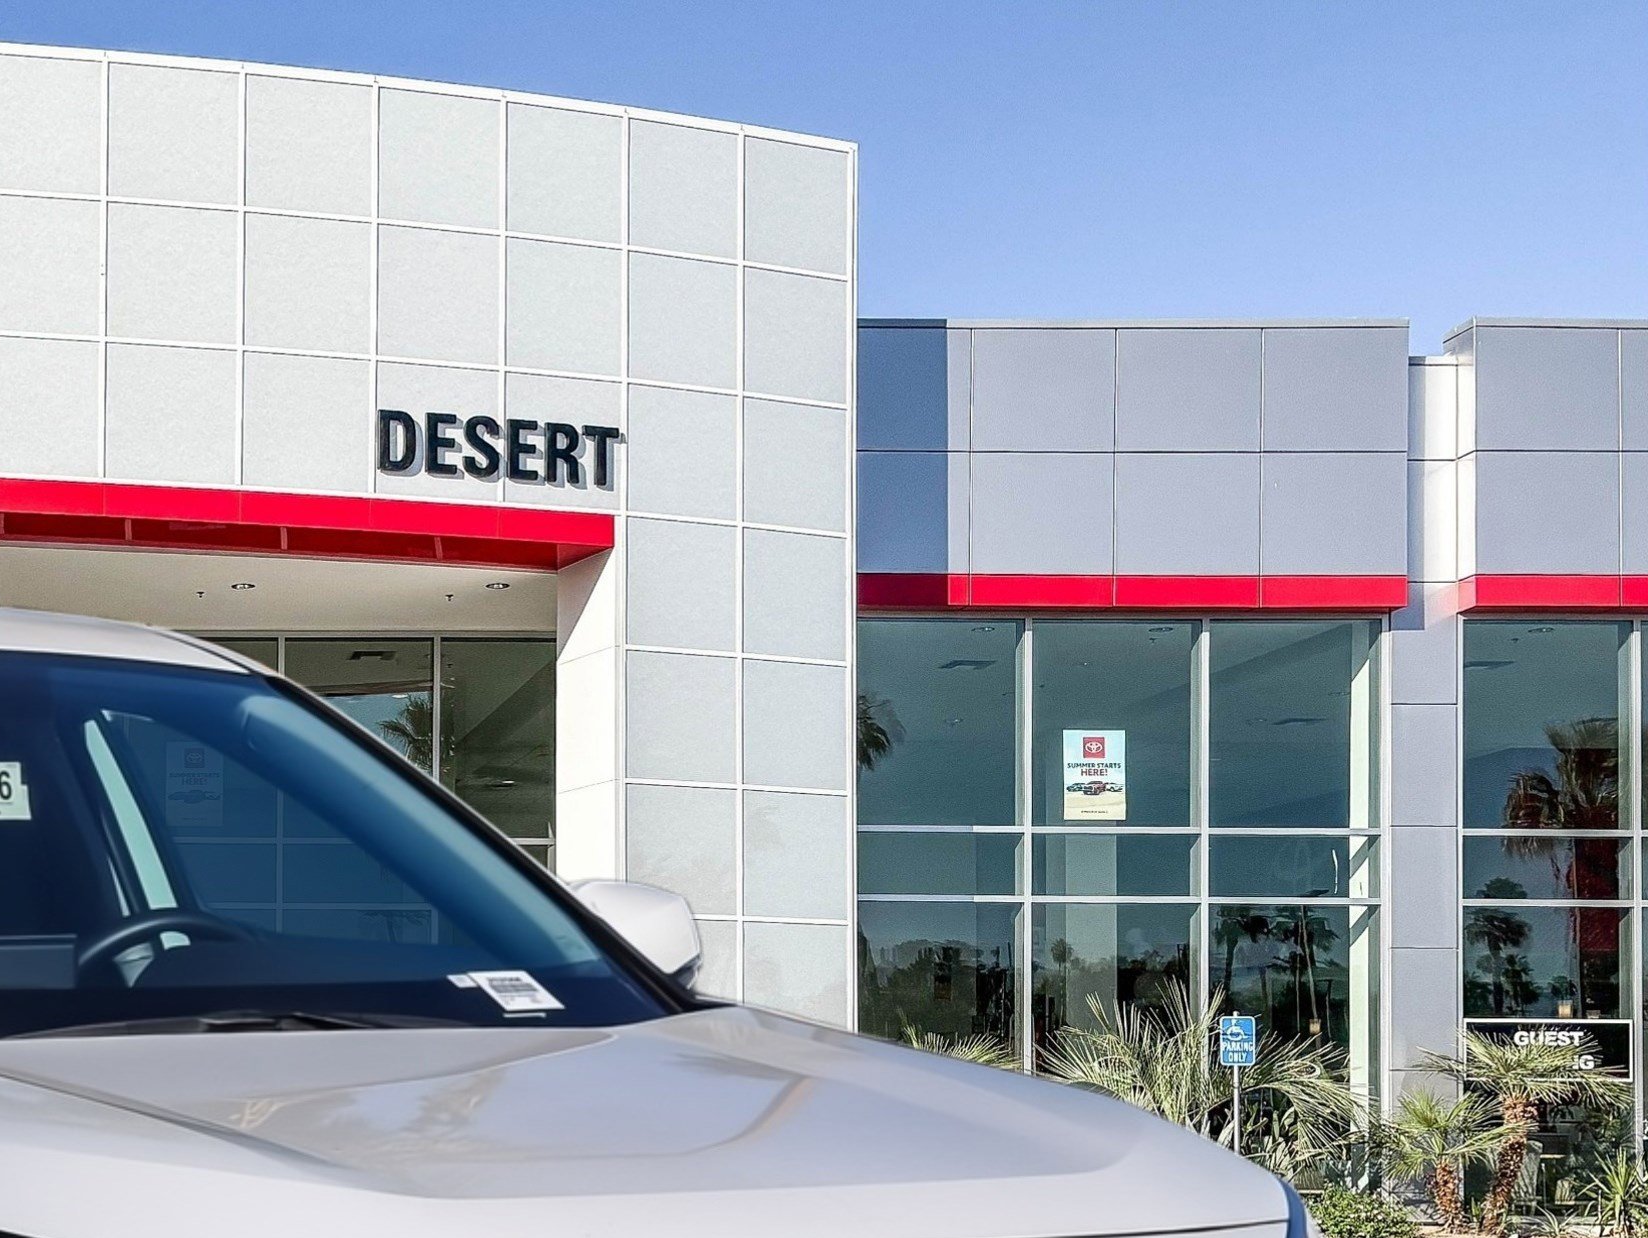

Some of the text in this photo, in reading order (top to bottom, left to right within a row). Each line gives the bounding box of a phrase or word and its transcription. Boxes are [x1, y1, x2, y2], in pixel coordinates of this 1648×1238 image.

[377, 409, 620, 486] DESERT
[1080, 768, 1108, 777] HERE!
[1513, 1030, 1585, 1047] GUEST
[1222, 1041, 1254, 1052] PARKING
[1228, 1051, 1248, 1063] ONLY
